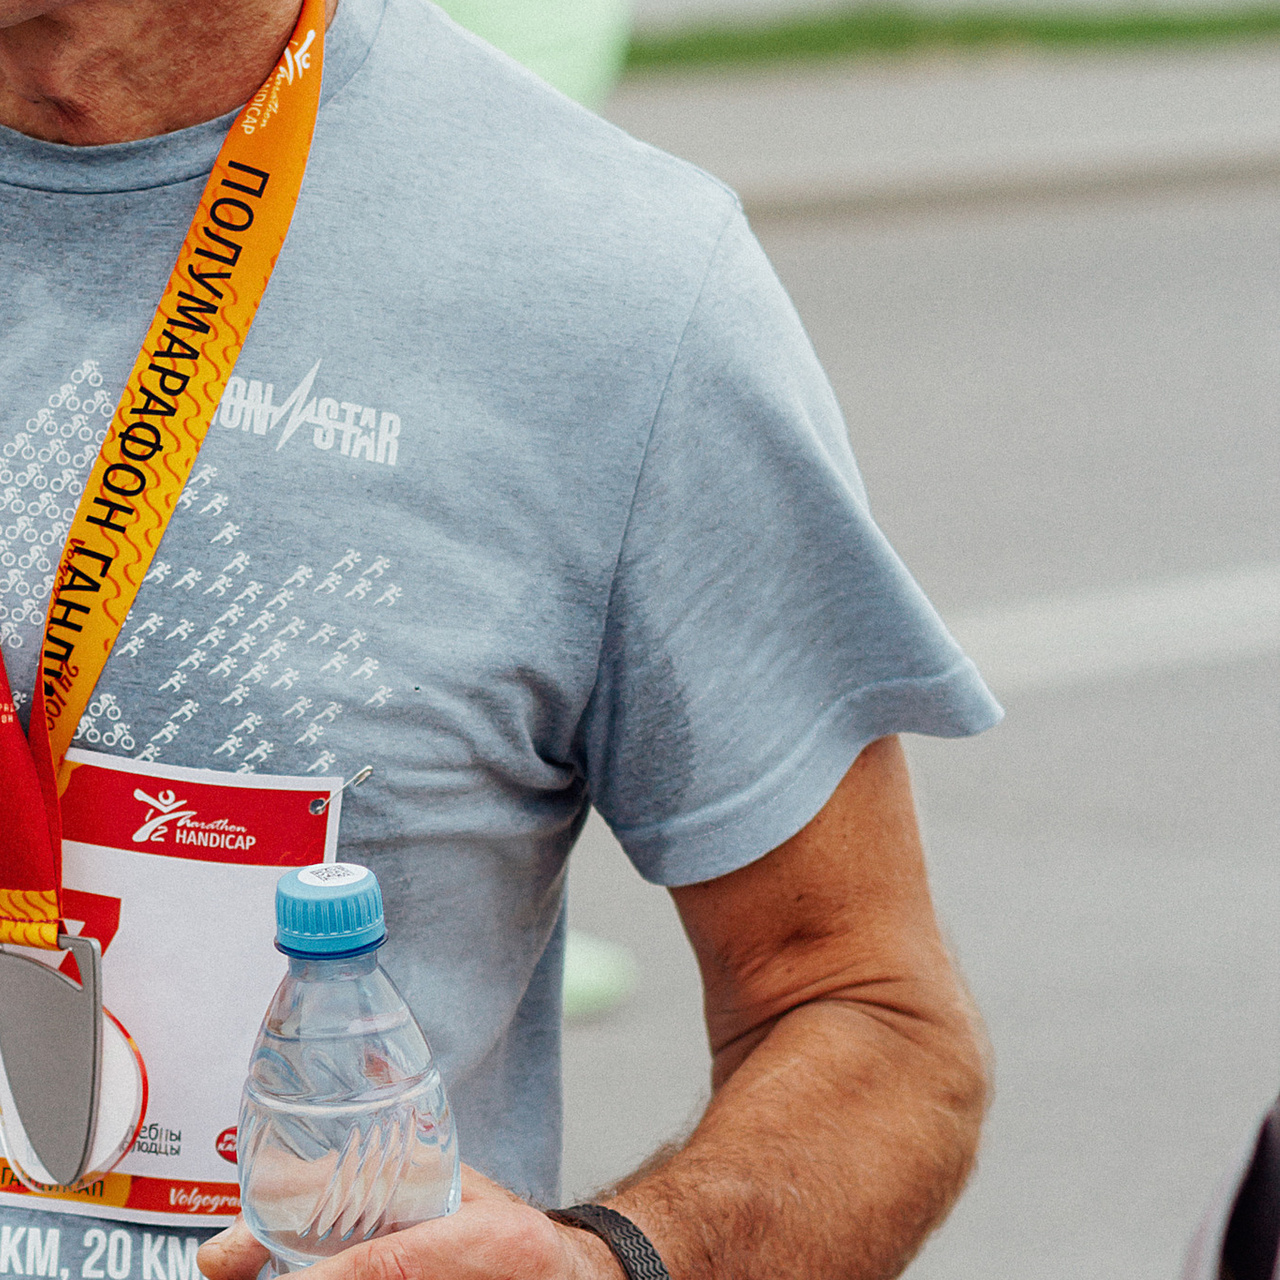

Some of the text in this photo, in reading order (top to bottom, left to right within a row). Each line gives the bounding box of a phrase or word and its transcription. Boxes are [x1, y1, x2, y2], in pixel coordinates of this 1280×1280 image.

[85, 160, 270, 534] ПОЛУМАРАФОН
[313, 396, 402, 466] STAR
[175, 828, 257, 851] HANDICAP
[169, 1186, 242, 1213] Volgogra
[81, 1228, 134, 1280] 20
